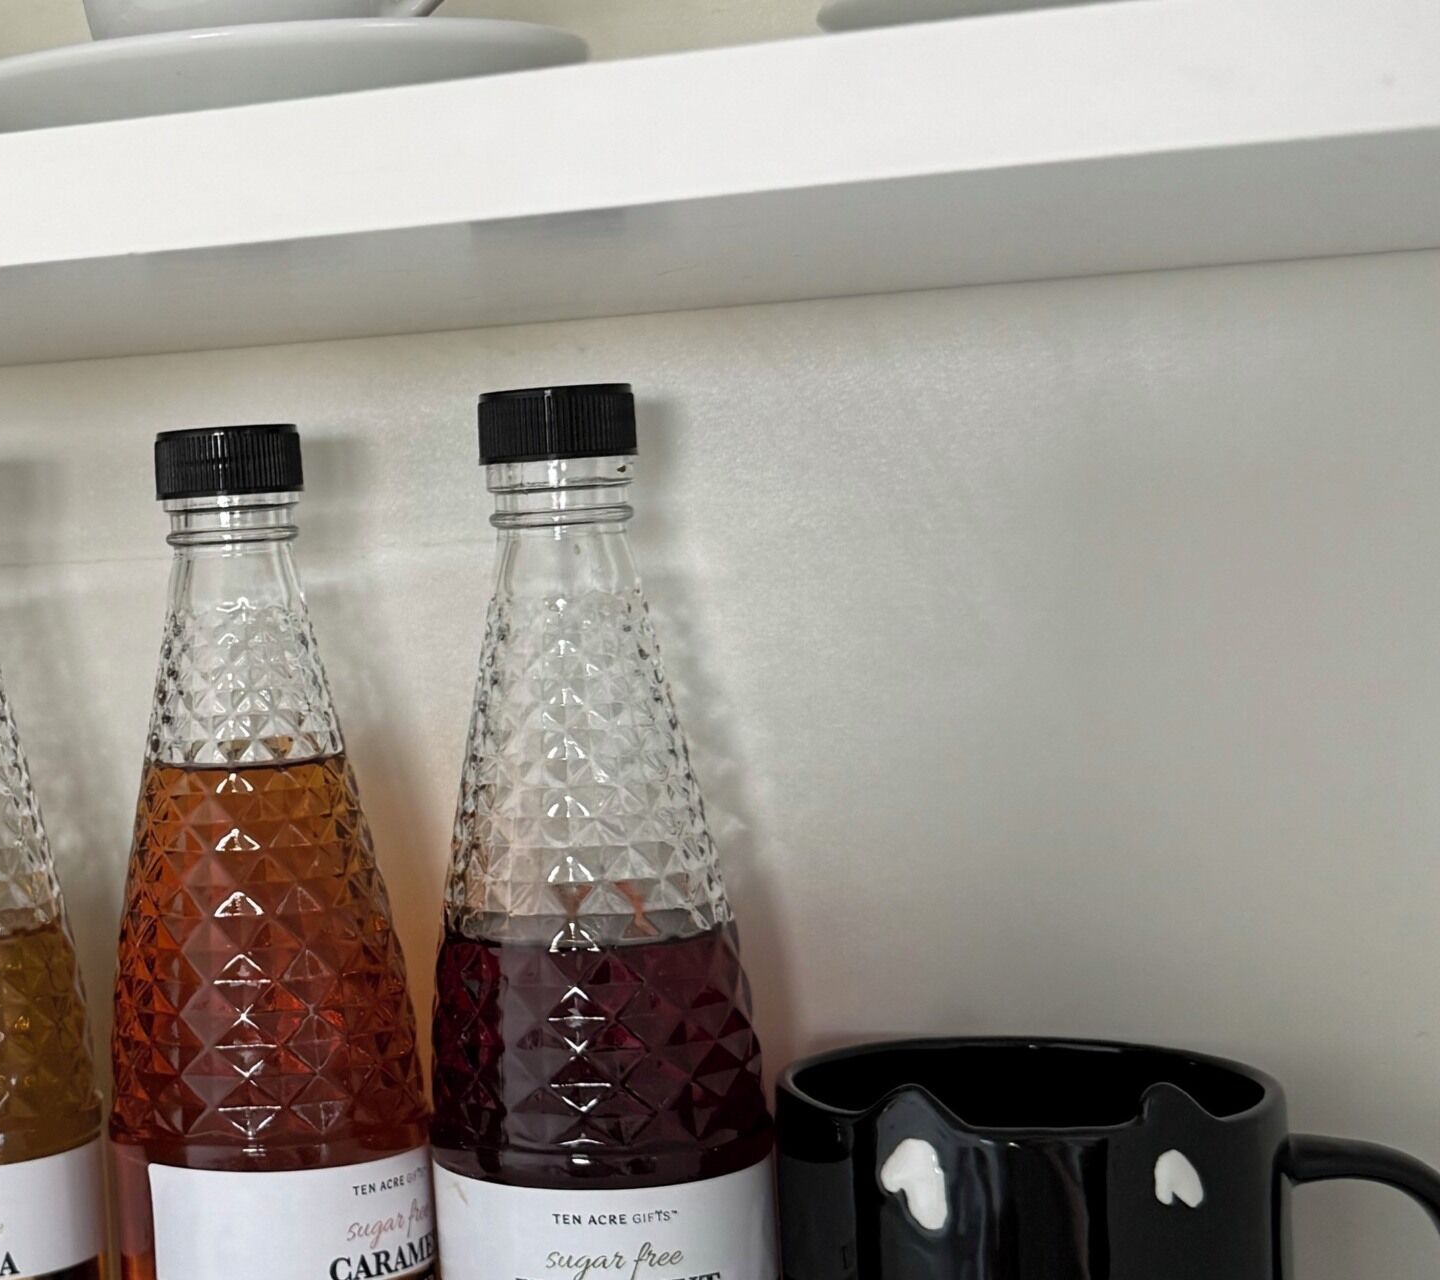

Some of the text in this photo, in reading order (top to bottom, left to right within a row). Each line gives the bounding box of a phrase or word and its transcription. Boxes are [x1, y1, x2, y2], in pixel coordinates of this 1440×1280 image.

[352, 1182, 376, 1196] TEN
[379, 1175, 405, 1192] ACRE
[552, 1213, 582, 1225] TEN
[588, 1213, 628, 1226] ACRE
[346, 1212, 405, 1249] sugar
